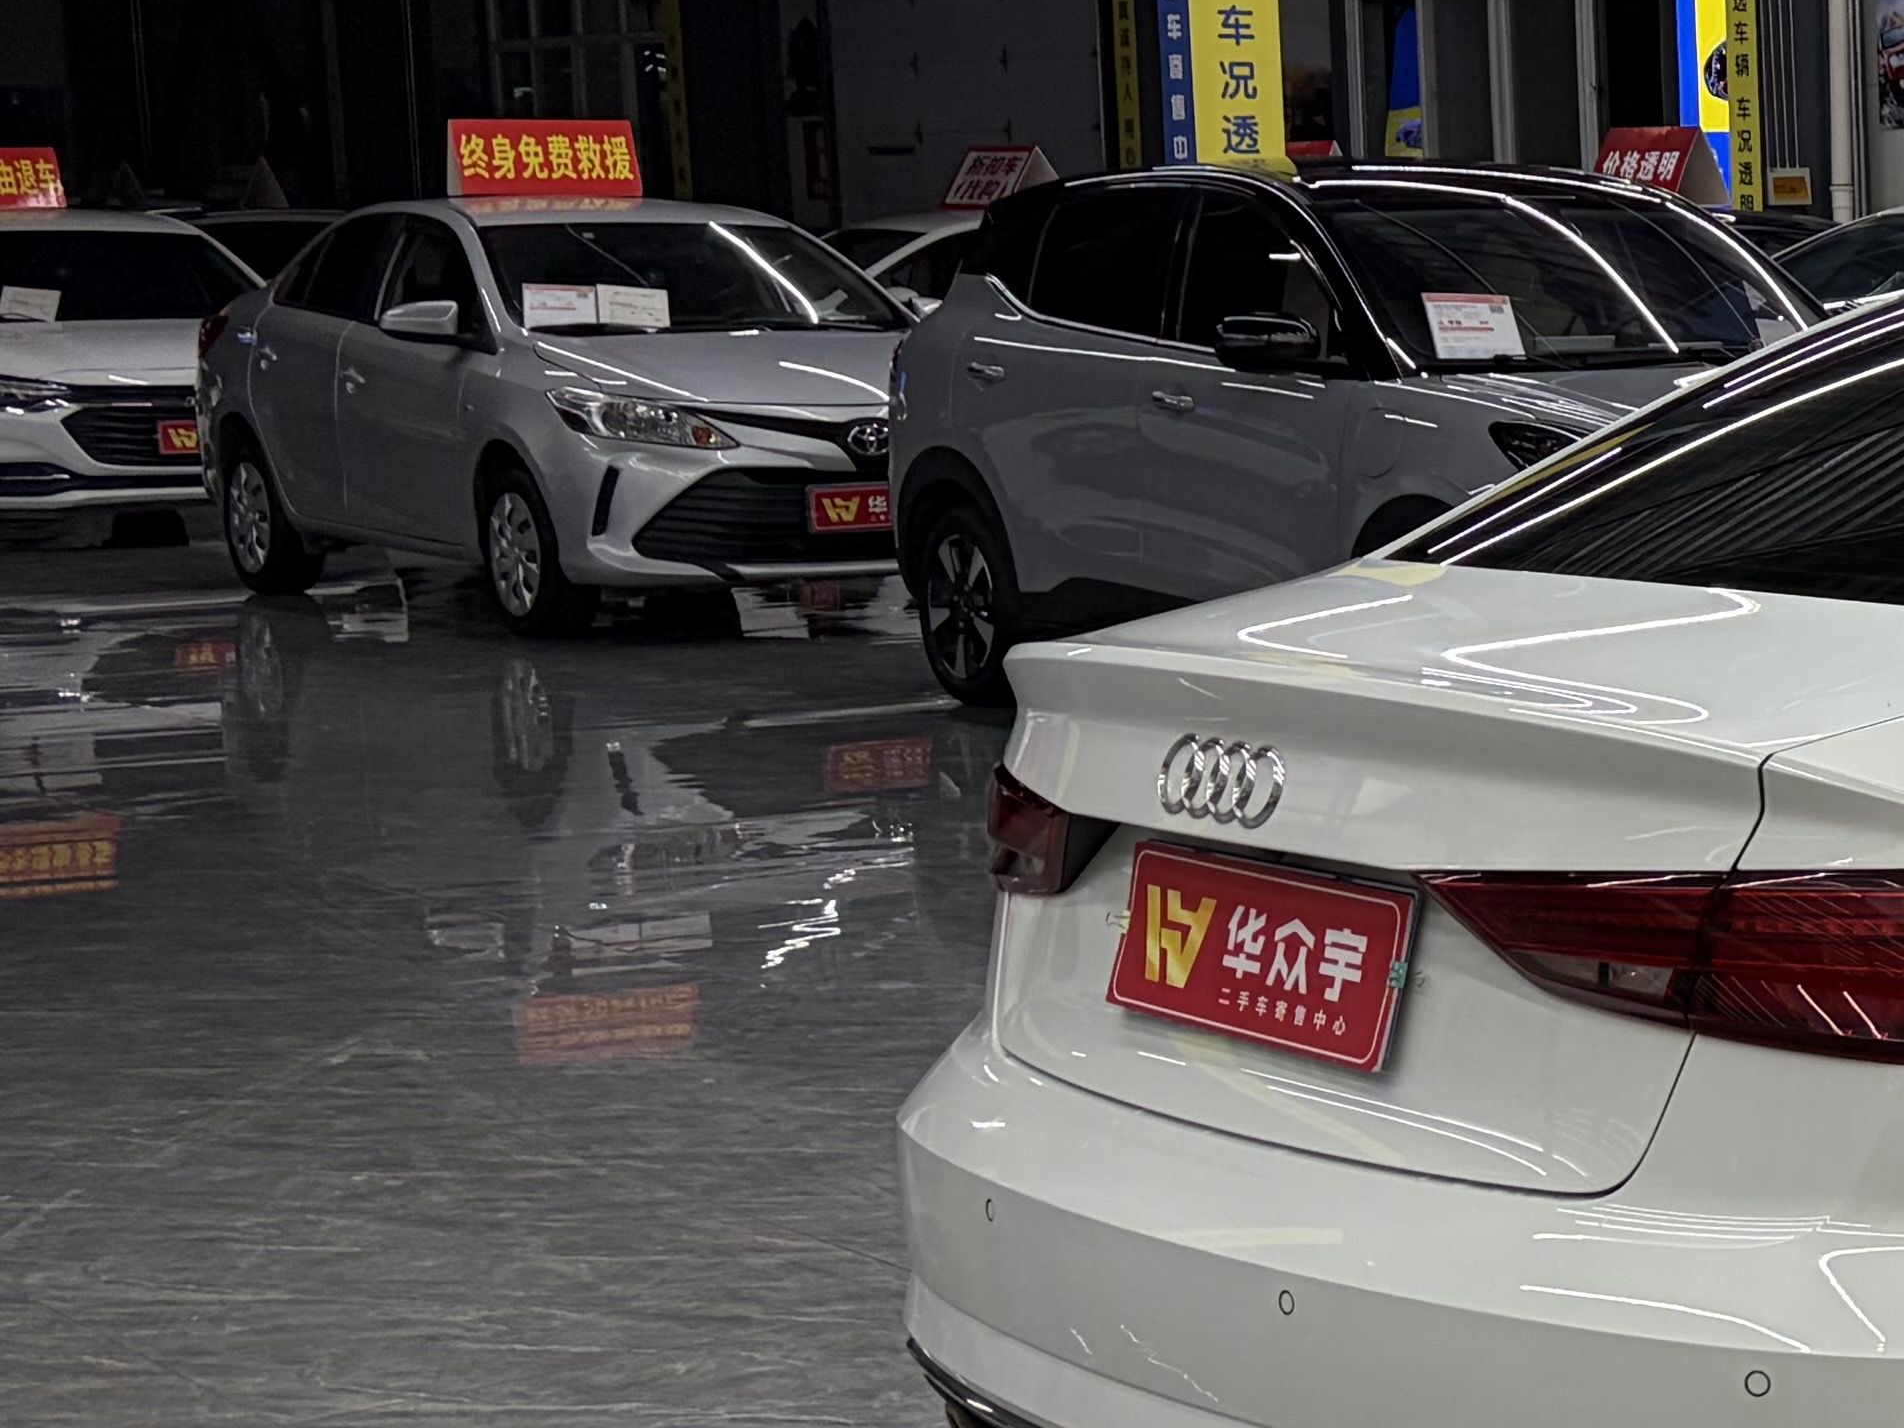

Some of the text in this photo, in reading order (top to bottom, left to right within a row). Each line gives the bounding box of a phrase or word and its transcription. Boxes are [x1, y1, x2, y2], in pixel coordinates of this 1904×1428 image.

[460, 134, 634, 180] 终身免费救援
[1602, 150, 1680, 181] 价格透明
[1221, 904, 1369, 1003] 华众宇
[1218, 987, 1346, 1036] 二手车寄售中心
